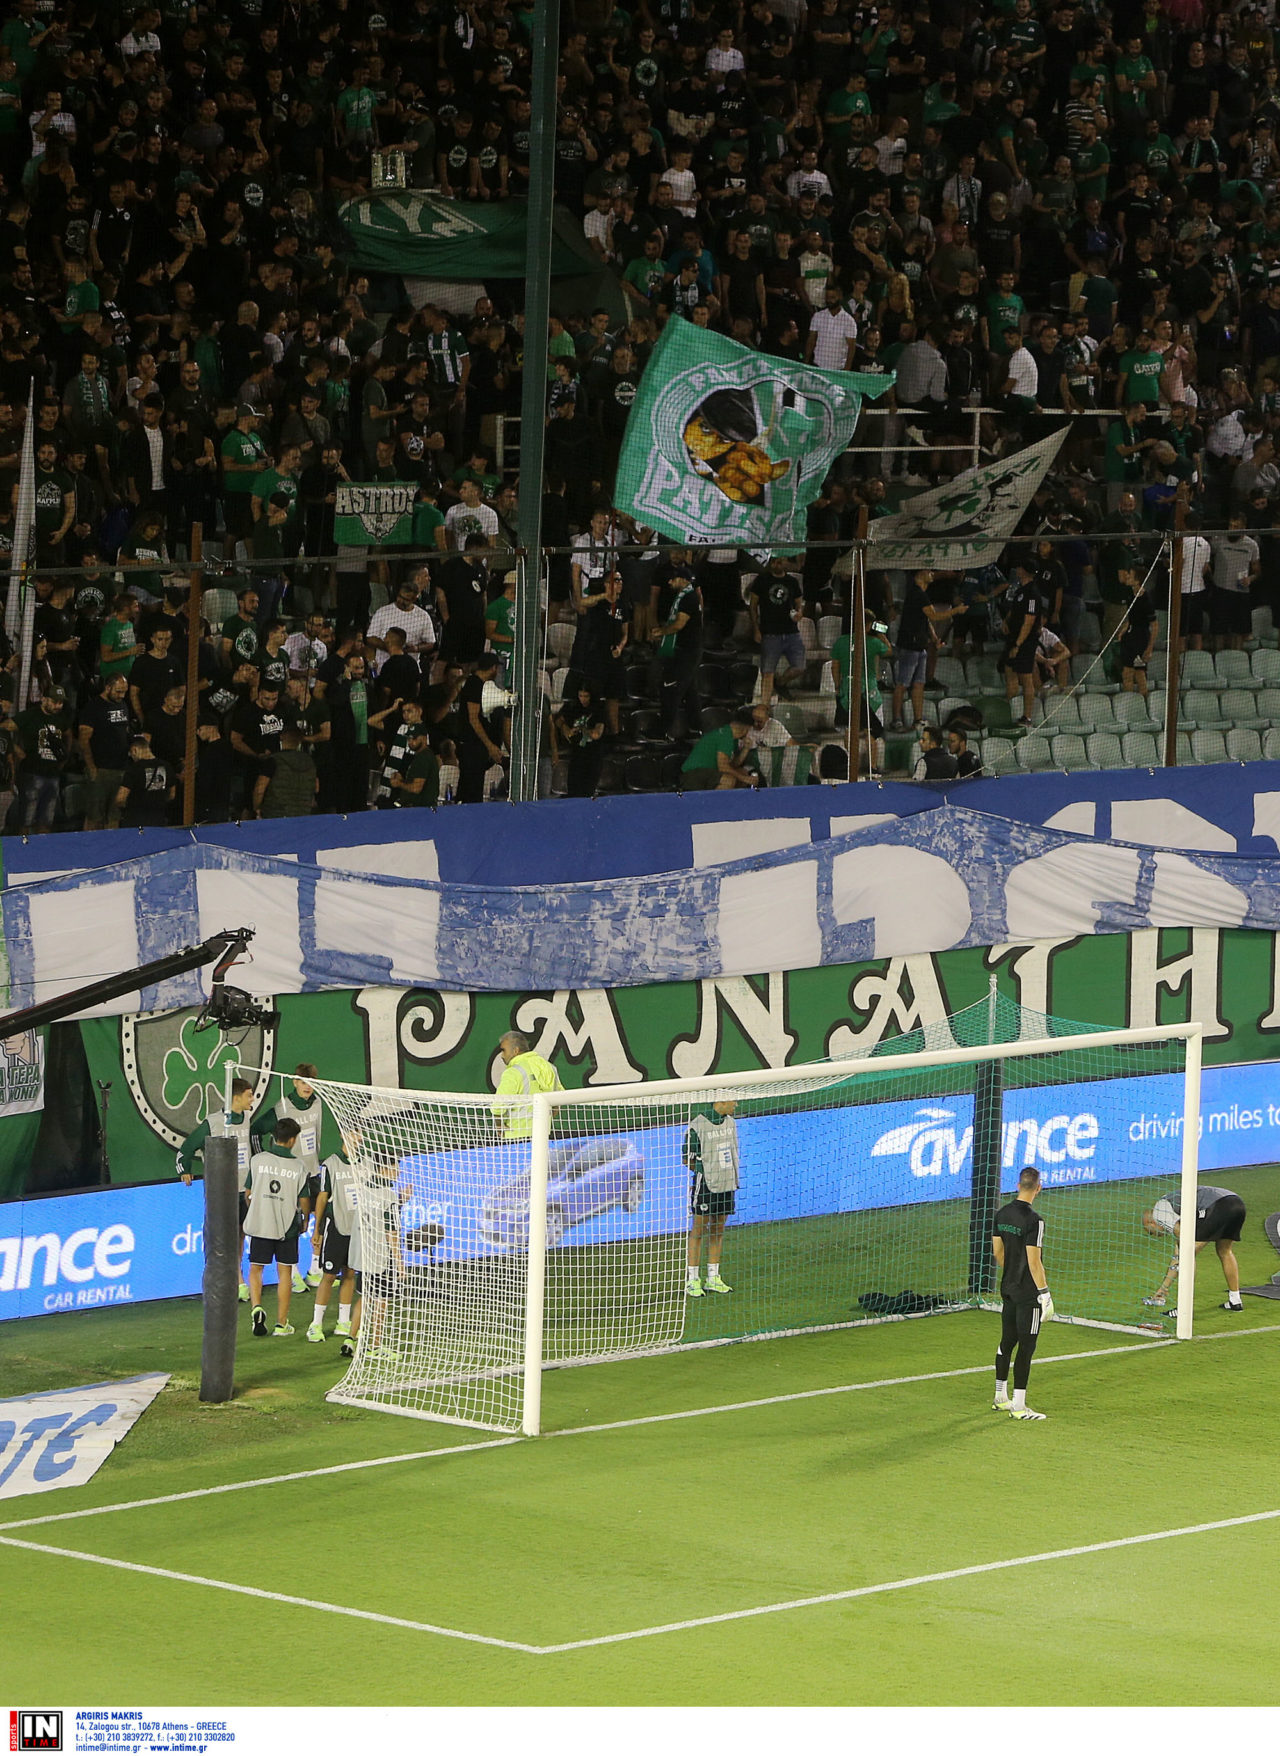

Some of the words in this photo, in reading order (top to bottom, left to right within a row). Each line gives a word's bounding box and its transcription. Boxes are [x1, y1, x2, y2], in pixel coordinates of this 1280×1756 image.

[1208, 1103, 1263, 1134] miles
[911, 1113, 1099, 1177] avnce
[258, 1165, 278, 1176] BALL
[280, 1169, 298, 1180] BOY
[1051, 1166, 1096, 1184] RENTAL
[43, 1291, 73, 1310] CAR
[76, 1284, 133, 1306] RENTAL
